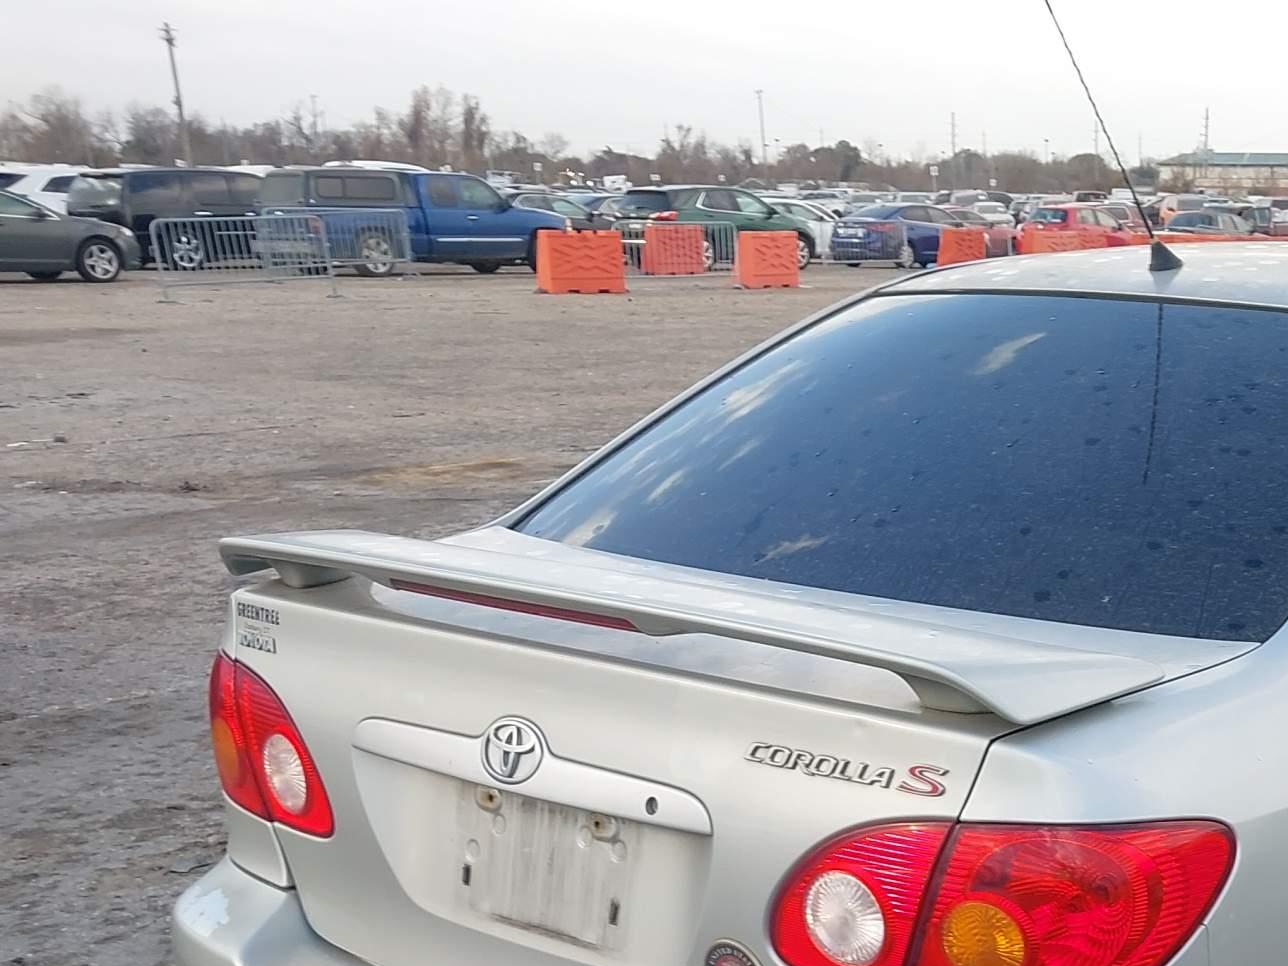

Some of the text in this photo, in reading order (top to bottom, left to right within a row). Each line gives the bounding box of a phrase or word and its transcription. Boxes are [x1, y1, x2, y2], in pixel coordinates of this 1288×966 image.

[237, 602, 280, 625] GREENTREE
[744, 741, 950, 797] COROLLA S
